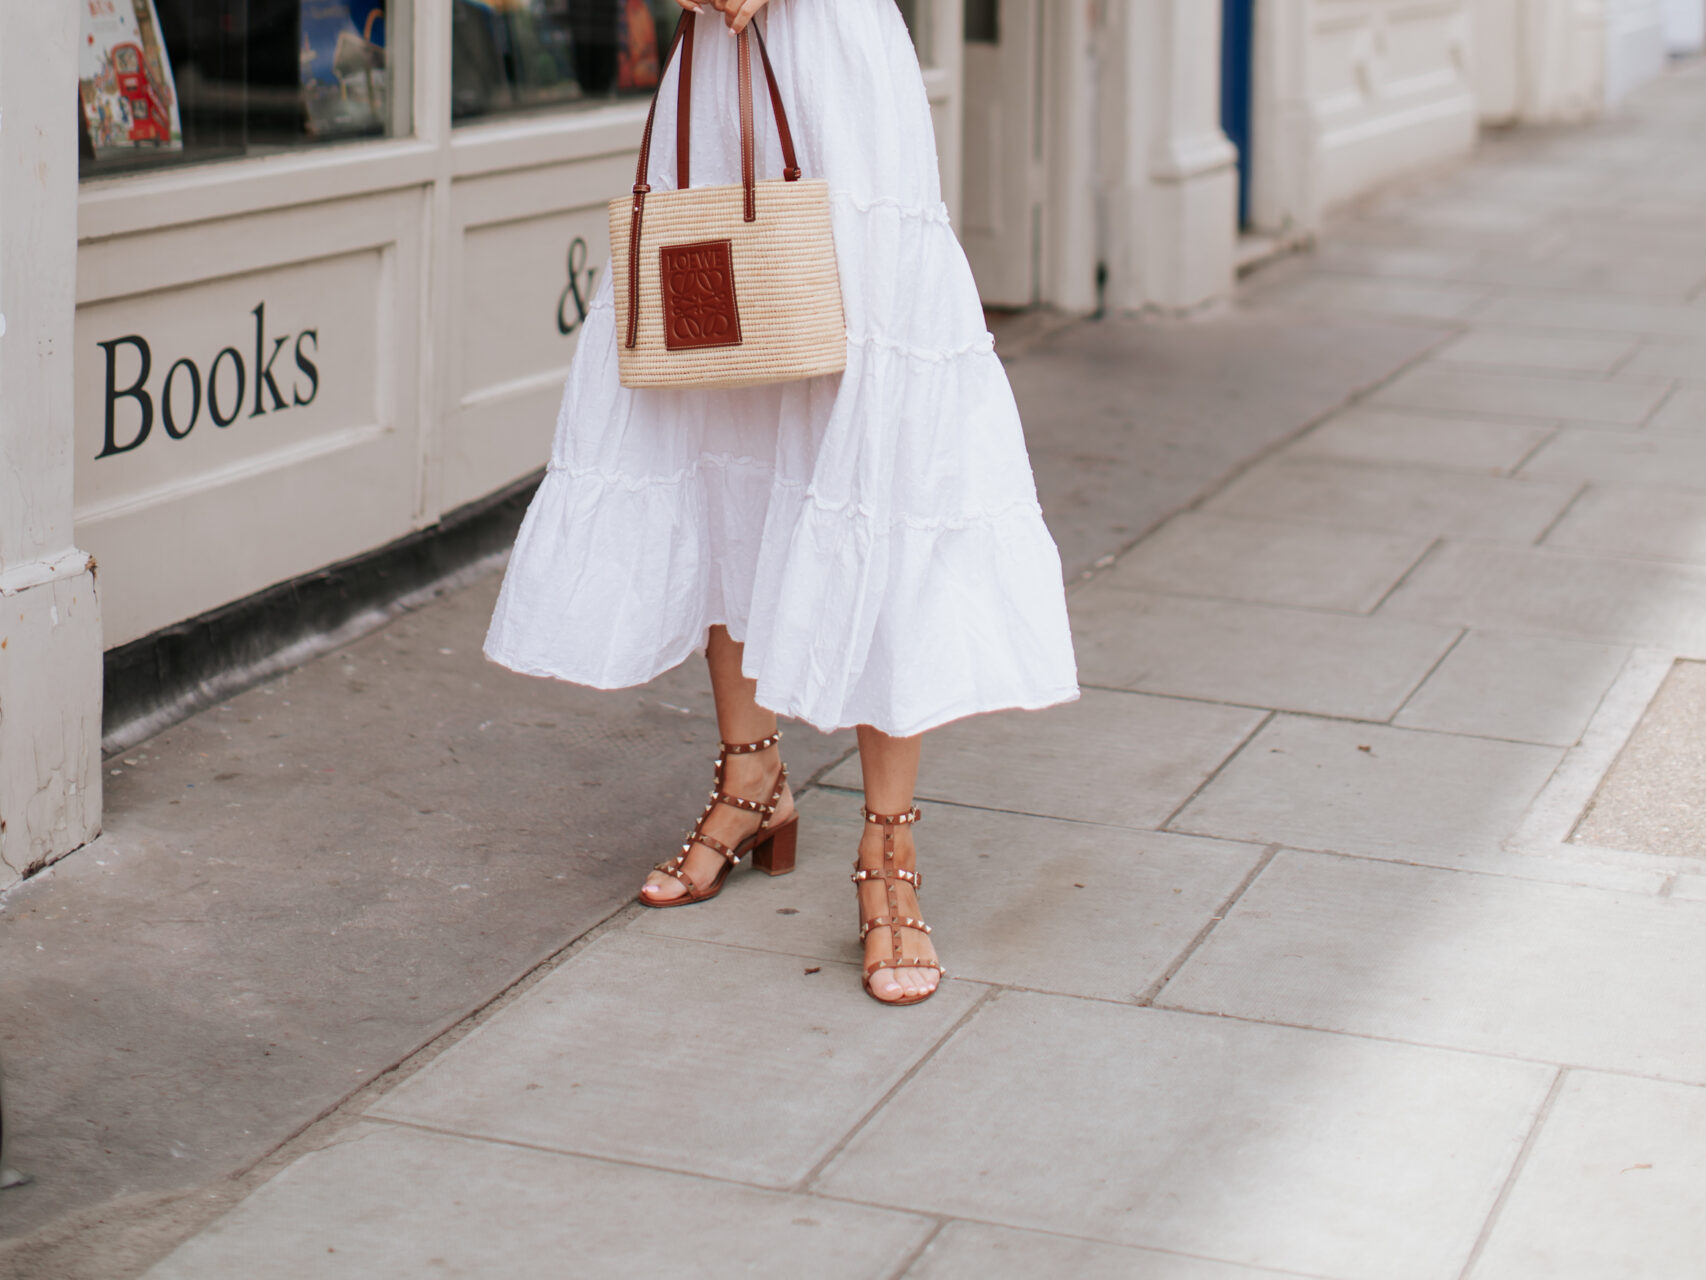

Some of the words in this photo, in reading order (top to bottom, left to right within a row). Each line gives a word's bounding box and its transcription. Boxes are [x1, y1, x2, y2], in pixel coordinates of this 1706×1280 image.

[666, 250, 724, 273] LOEWE
[94, 300, 319, 460] Books
[557, 236, 600, 336] &
